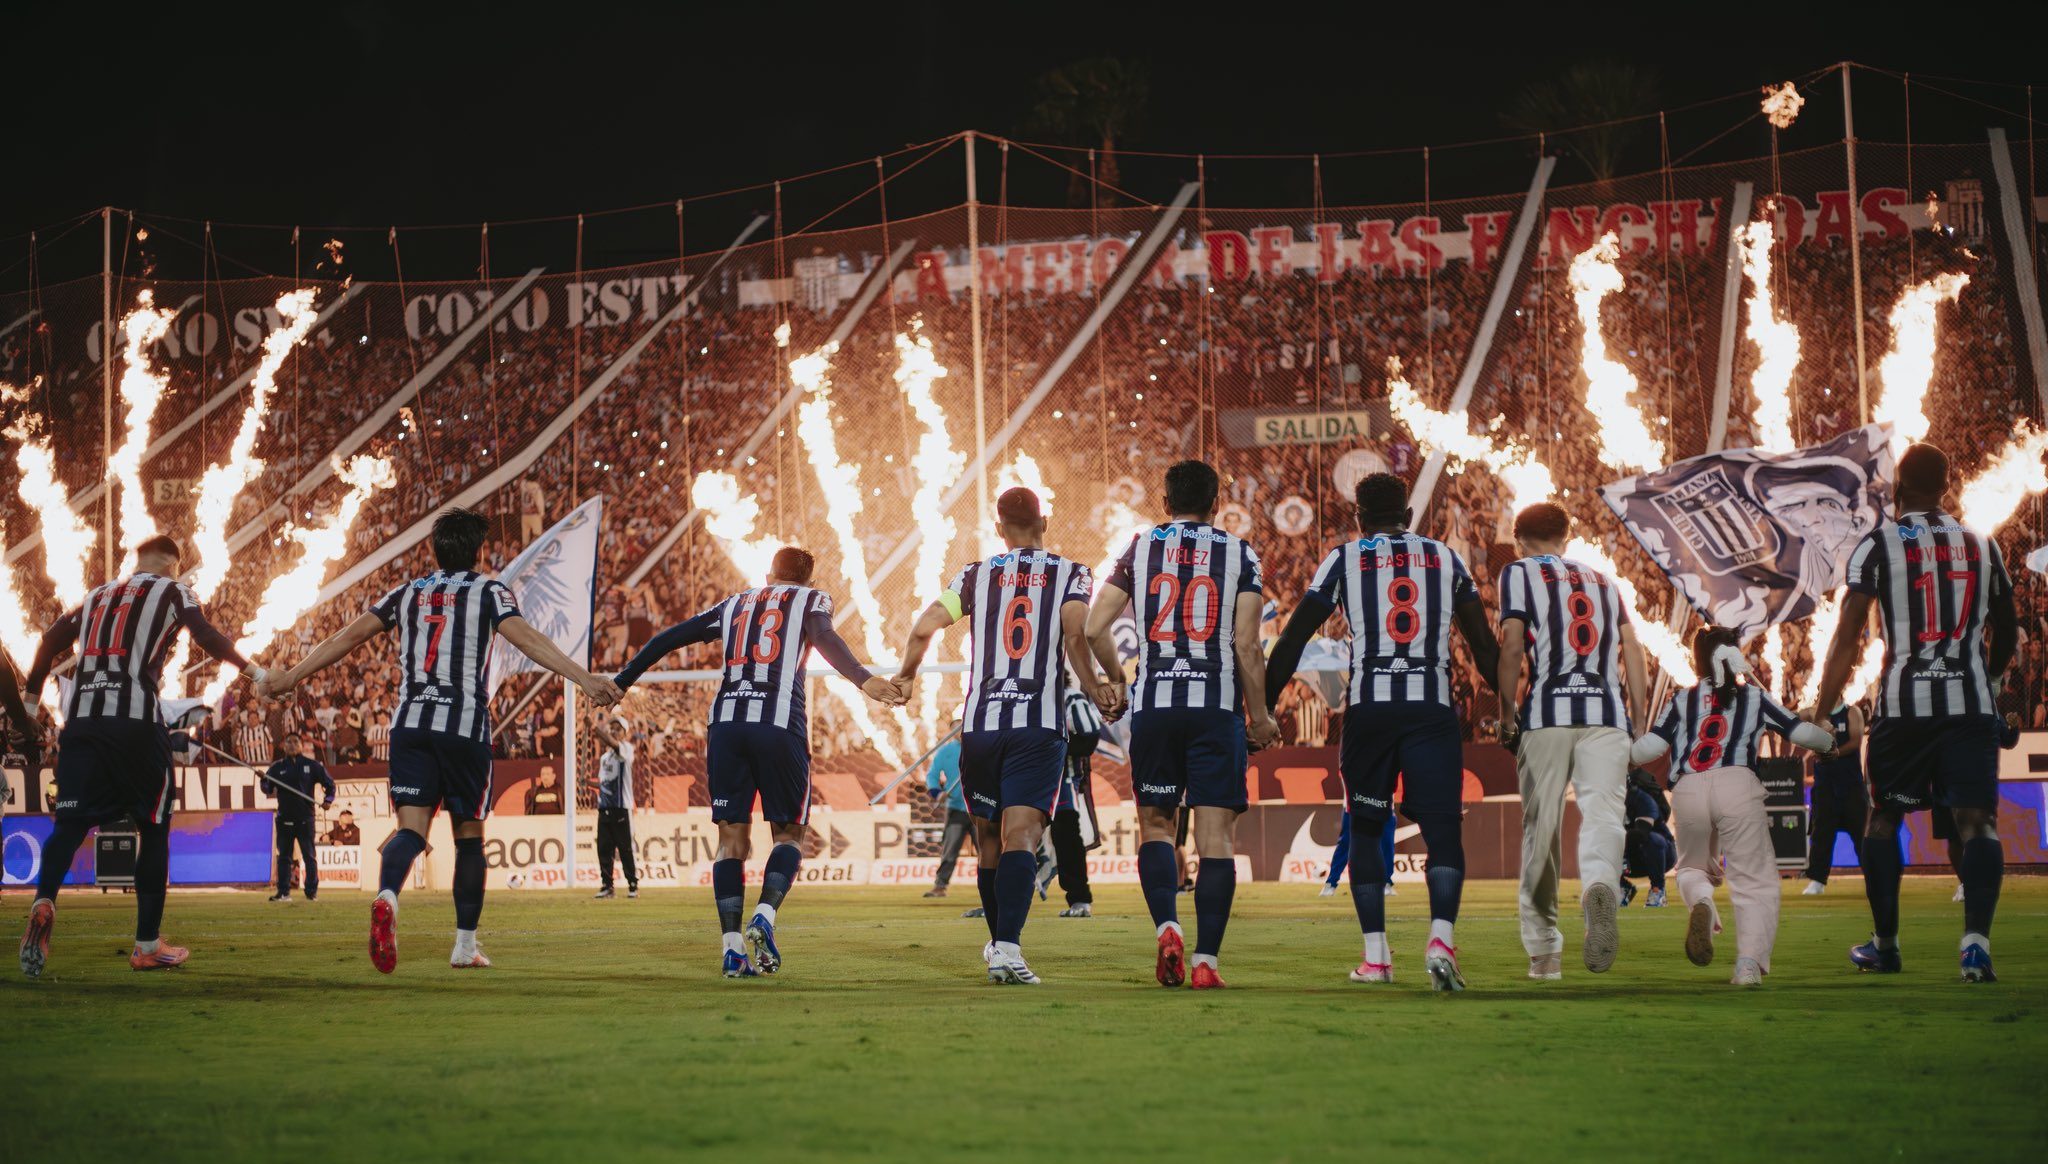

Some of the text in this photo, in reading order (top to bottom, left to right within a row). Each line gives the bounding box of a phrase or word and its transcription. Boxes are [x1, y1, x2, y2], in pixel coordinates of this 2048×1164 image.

[1204, 226, 1293, 282] DE
[1314, 216, 1446, 284] LAS
[1463, 186, 1910, 274] HNCHDAS
[404, 287, 549, 340] COO
[1264, 416, 1360, 441] SALIDA
[1182, 528, 1229, 544] Movistar
[1672, 514, 1706, 551] CLUB
[1166, 544, 1209, 566] VÉLEZ
[1376, 553, 1442, 569] CASTILLO
[998, 572, 1049, 588] GARCES
[417, 592, 457, 608] GAIBOR
[1149, 572, 1219, 643] 20
[1385, 576, 1421, 645] 8
[1914, 571, 1977, 642] 17
[83, 602, 132, 657] 11
[1003, 595, 1034, 660] 6
[1567, 591, 1599, 656] 8
[423, 614, 448, 673] 7
[727, 608, 785, 667] 13
[1154, 670, 1208, 679] ANYPSA
[1912, 671, 1965, 680] ANYPSA
[80, 682, 123, 691] ANYPSA
[723, 690, 768, 699] ANYPSA
[989, 691, 1034, 701] ANYPSA
[1552, 686, 1604, 695] ANYPSA
[412, 694, 453, 704] ANYPSA
[1688, 713, 1729, 772] 8
[1140, 782, 1177, 795] JetSMART
[881, 860, 978, 883] apueta
